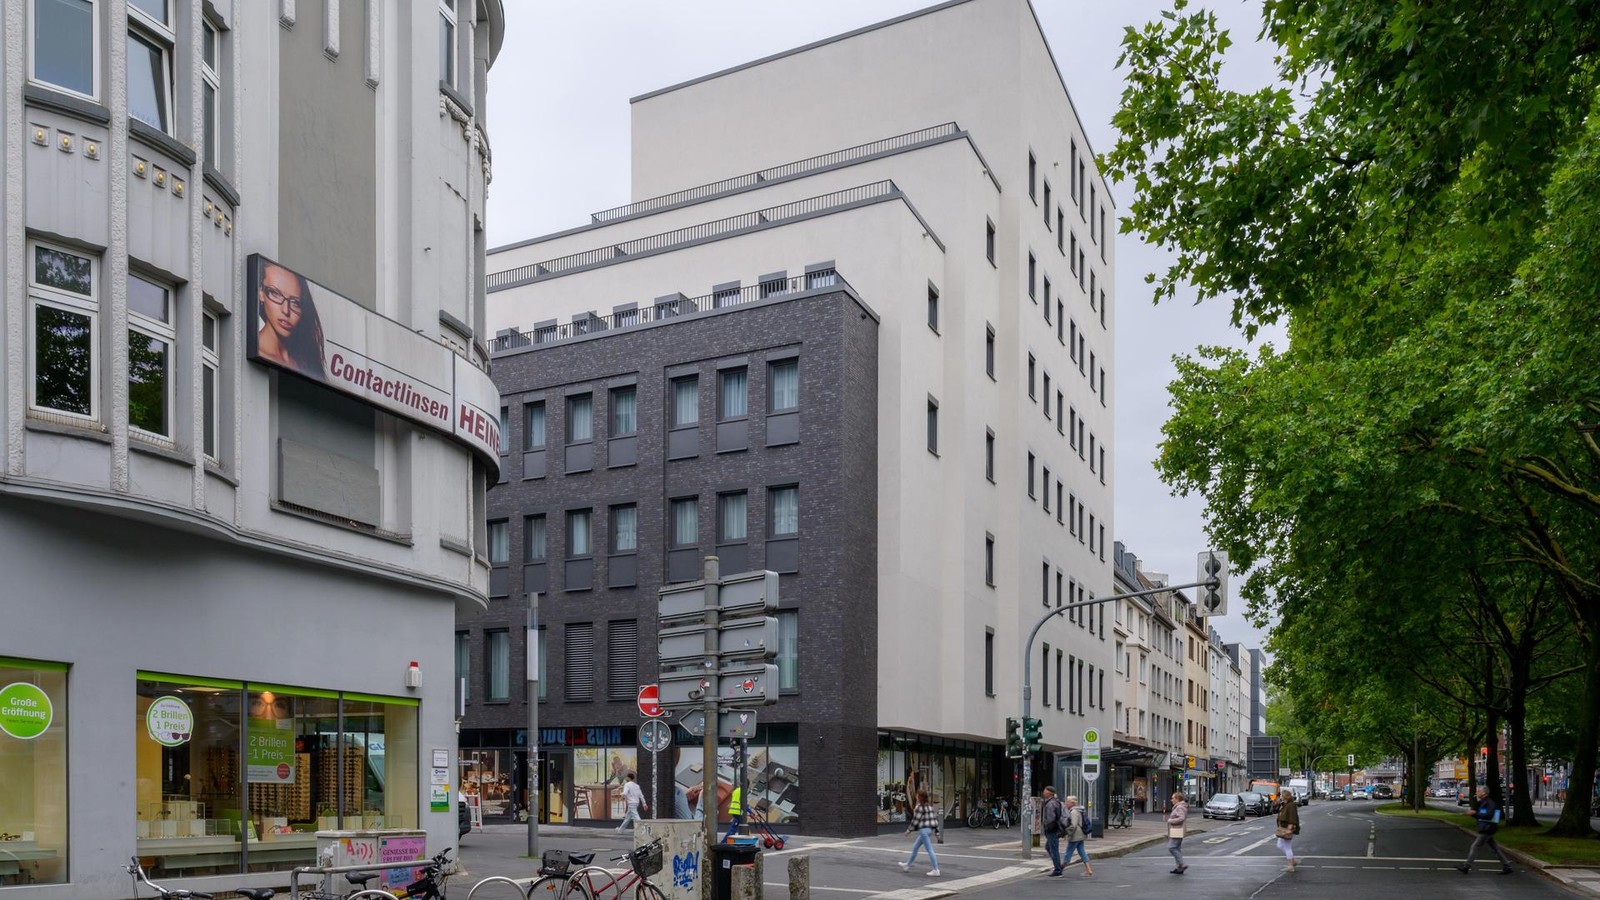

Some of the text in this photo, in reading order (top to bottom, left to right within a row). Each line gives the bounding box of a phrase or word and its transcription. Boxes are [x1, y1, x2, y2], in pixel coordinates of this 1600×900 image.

[330, 353, 449, 421] Contactlinsen
[10, 697, 37, 706] Große
[1, 707, 46, 720] Eröffnung
[153, 709, 188, 720] 2 Brillen
[156, 720, 185, 730] 1 Preis
[249, 736, 287, 748] 2 Brillen
[253, 749, 284, 760] 1 Preis
